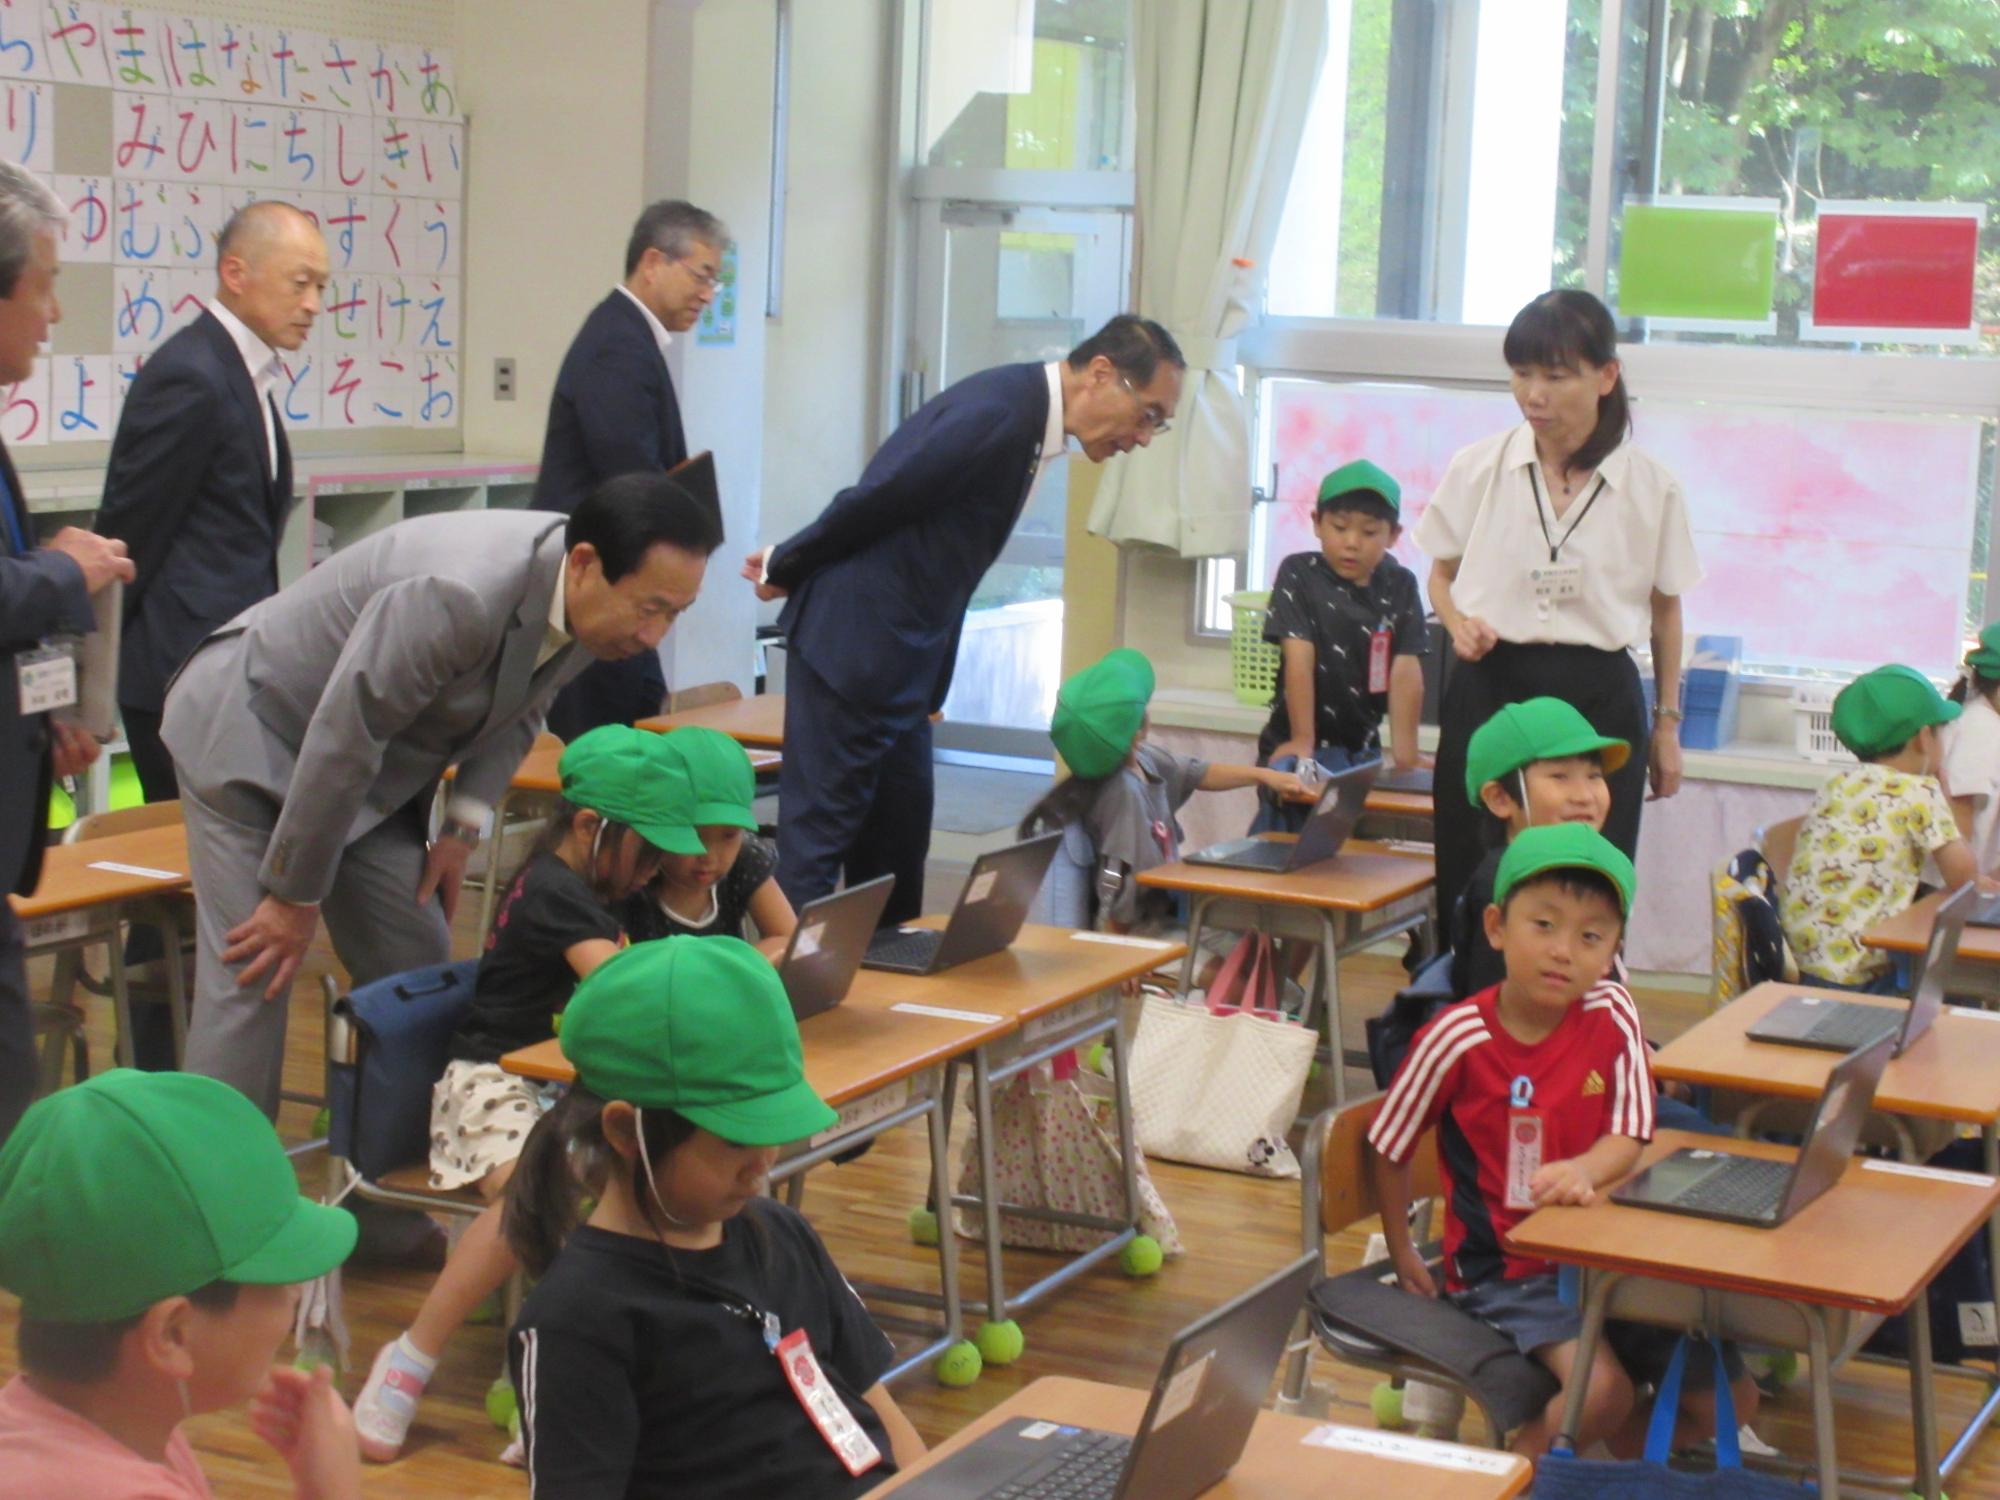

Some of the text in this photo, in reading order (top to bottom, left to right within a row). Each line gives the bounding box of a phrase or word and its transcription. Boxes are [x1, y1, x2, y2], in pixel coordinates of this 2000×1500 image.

[50, 6, 97, 78] や
[113, 14, 155, 84] ま
[165, 22, 216, 87] は
[220, 28, 262, 94] な
[272, 34, 317, 101] た
[324, 43, 357, 107] さ
[370, 50, 410, 112] か
[420, 51, 454, 116] あ
[9, 88, 36, 164] り
[118, 104, 165, 169] み
[178, 112, 216, 173] ひ
[230, 113, 268, 174] に
[284, 112, 315, 182] ち
[339, 122, 365, 186] し
[381, 118, 410, 190] き
[421, 141, 459, 183] い
[119, 185, 166, 259] む
[172, 193, 220, 258] ふ
[327, 196, 366, 268] す
[385, 203, 400, 267] く
[425, 203, 447, 271] う
[119, 281, 163, 340] め
[327, 281, 367, 338] せ
[378, 279, 411, 341] け
[421, 281, 452, 346] え
[61, 364, 98, 431] よ
[283, 363, 310, 420] と
[328, 358, 362, 424] そ
[375, 361, 404, 417] こ
[420, 356, 456, 421] お
